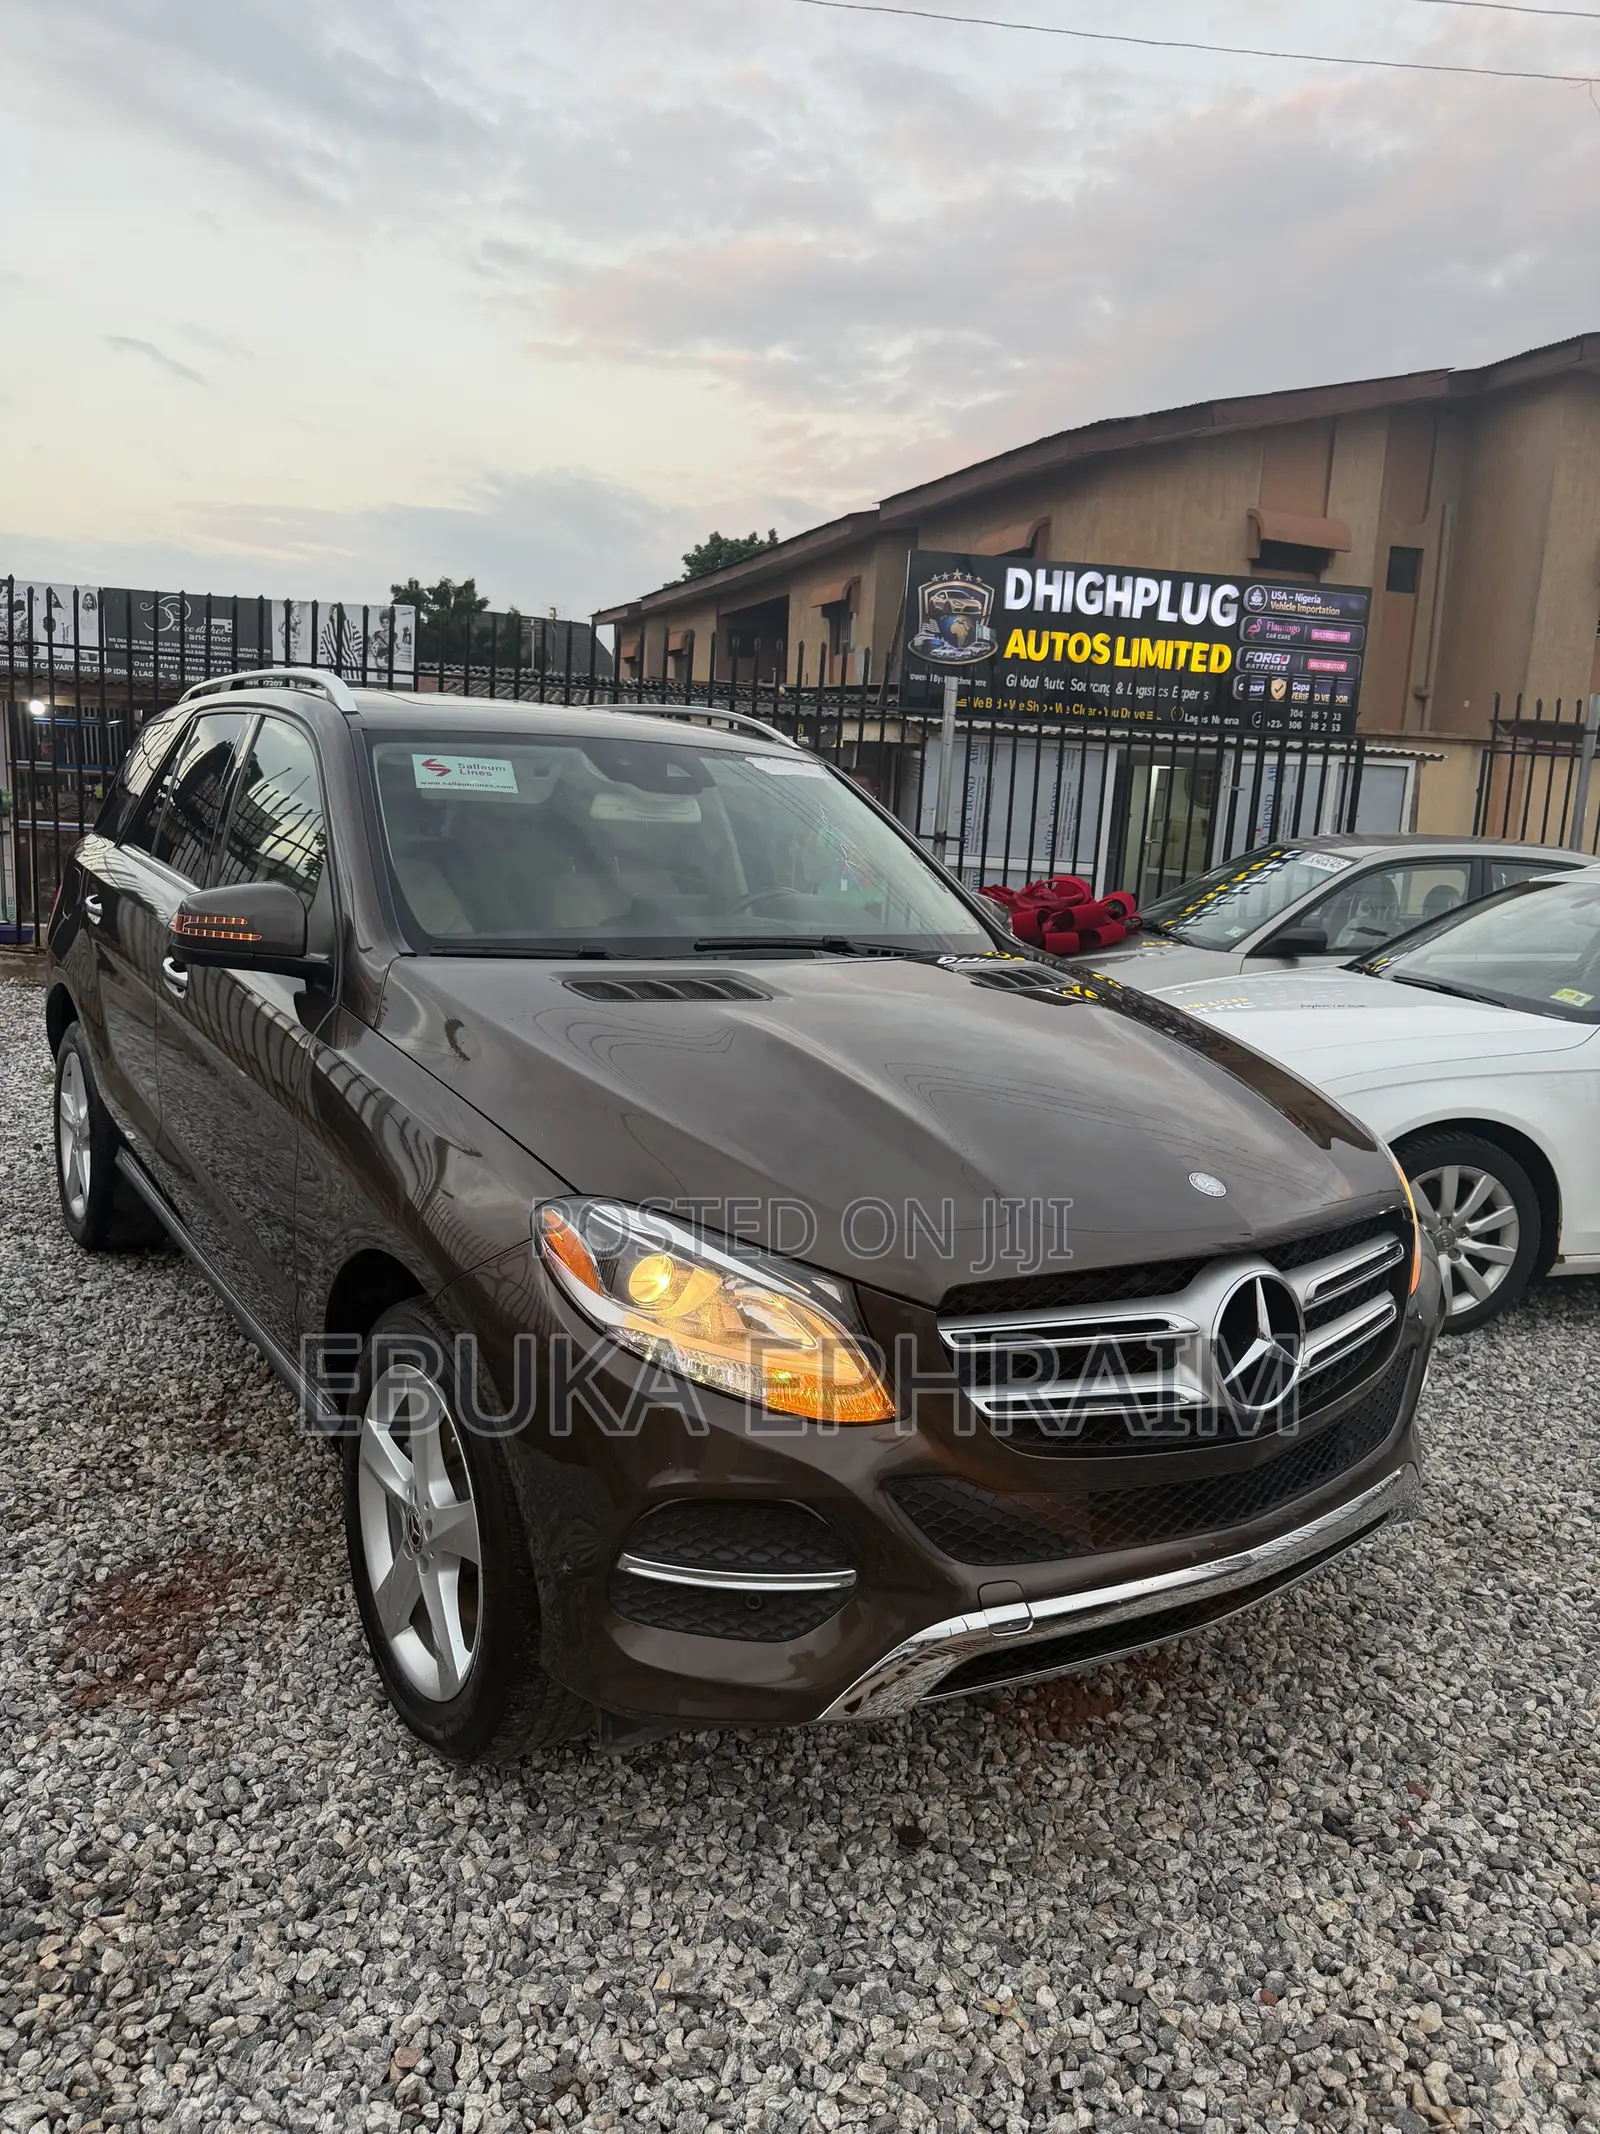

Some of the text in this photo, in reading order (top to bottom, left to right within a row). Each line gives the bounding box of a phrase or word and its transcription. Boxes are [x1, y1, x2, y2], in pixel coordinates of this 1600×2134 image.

[1004, 567, 1240, 628] DHIGHPLUG
[1271, 590, 1288, 601] USA
[1294, 592, 1322, 605] Nigeria
[1270, 600, 1341, 617] Vehicle Importation
[1266, 621, 1301, 636] Flamingo
[1265, 632, 1291, 641] CAR CARE
[1312, 632, 1349, 641] DISTRIBUTOR
[1003, 628, 1232, 674] AUTOS LIMITED
[1244, 652, 1291, 665] FORGO
[40, 662, 75, 671] CAVARY
[139, 670, 166, 679] LAGS.
[1245, 662, 1288, 672] BATTERIES
[1308, 660, 1346, 671] DISTRIBUTOR
[1006, 673, 1040, 689] Glbal
[1115, 681, 1125, 695] &
[1126, 682, 1169, 700] Lgistcs
[1171, 685, 1210, 702] Epers
[985, 697, 1002, 710] Bd
[1072, 703, 1097, 716] Clar
[1184, 713, 1240, 726] Lags Nieria
[459, 768, 493, 777] Lines
